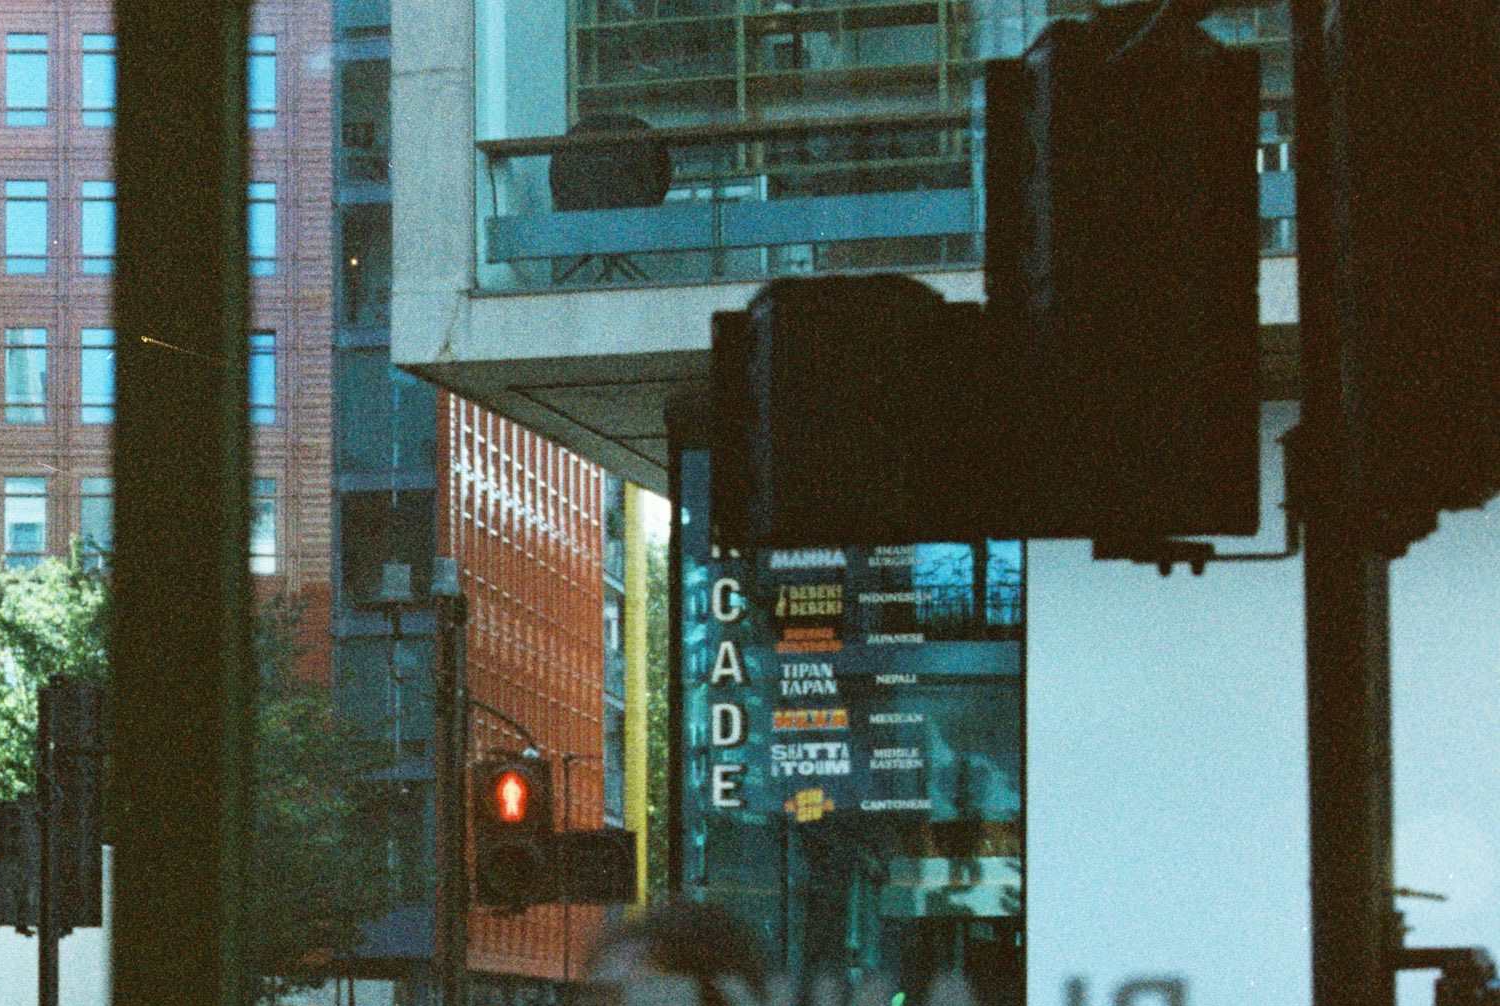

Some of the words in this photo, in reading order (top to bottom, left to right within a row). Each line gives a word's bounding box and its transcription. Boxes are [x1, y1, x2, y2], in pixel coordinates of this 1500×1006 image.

[866, 633, 925, 644] JAPANESE
[781, 662, 834, 678] TIPAN
[711, 545, 743, 808] CADE
[876, 674, 917, 684] NEPALI
[780, 679, 838, 695] TAPAN
[869, 713, 924, 724] MEXICAN
[873, 748, 920, 758] MIDDLE
[870, 759, 924, 769] EASTERN
[860, 799, 933, 811] CANTONESE
